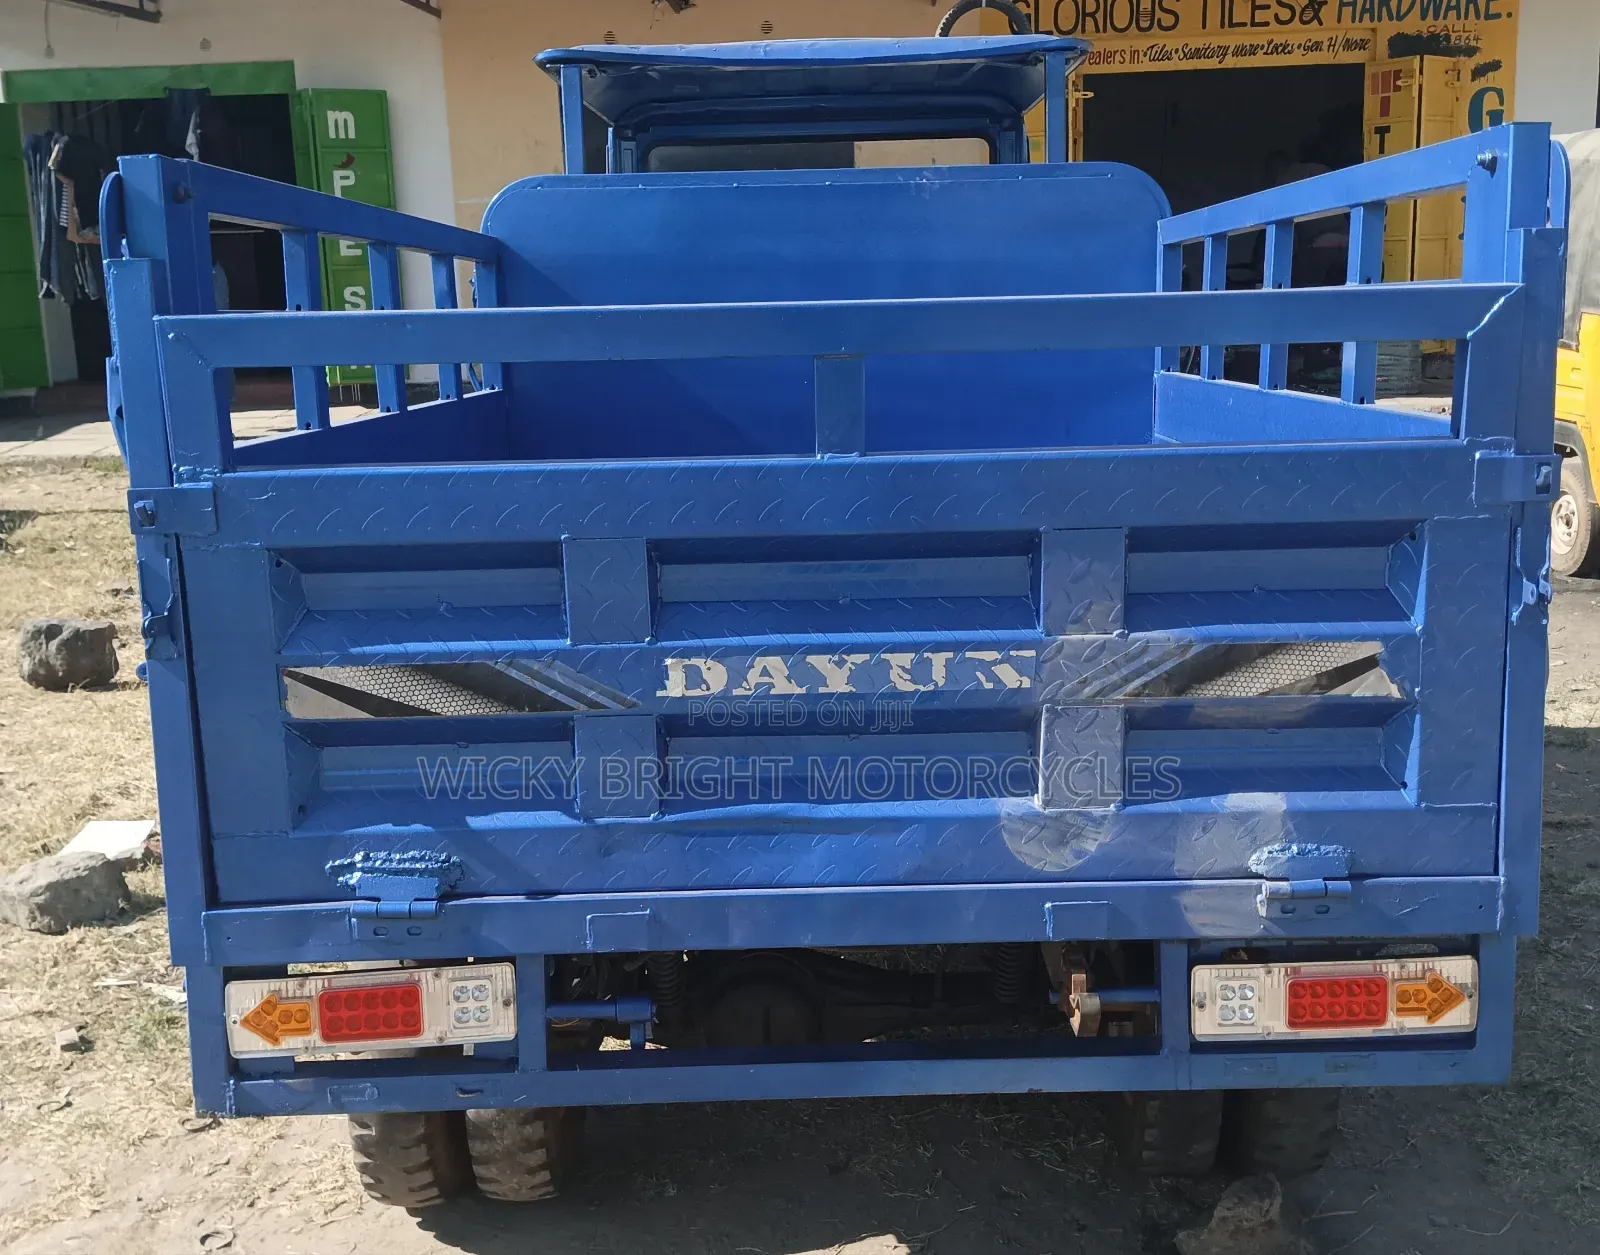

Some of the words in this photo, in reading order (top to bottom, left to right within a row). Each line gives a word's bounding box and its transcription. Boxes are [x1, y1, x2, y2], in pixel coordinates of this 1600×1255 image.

[1080, 48, 1126, 66] ealers
[1178, 43, 1230, 64] Sanitary
[1263, 38, 1295, 56] Locks
